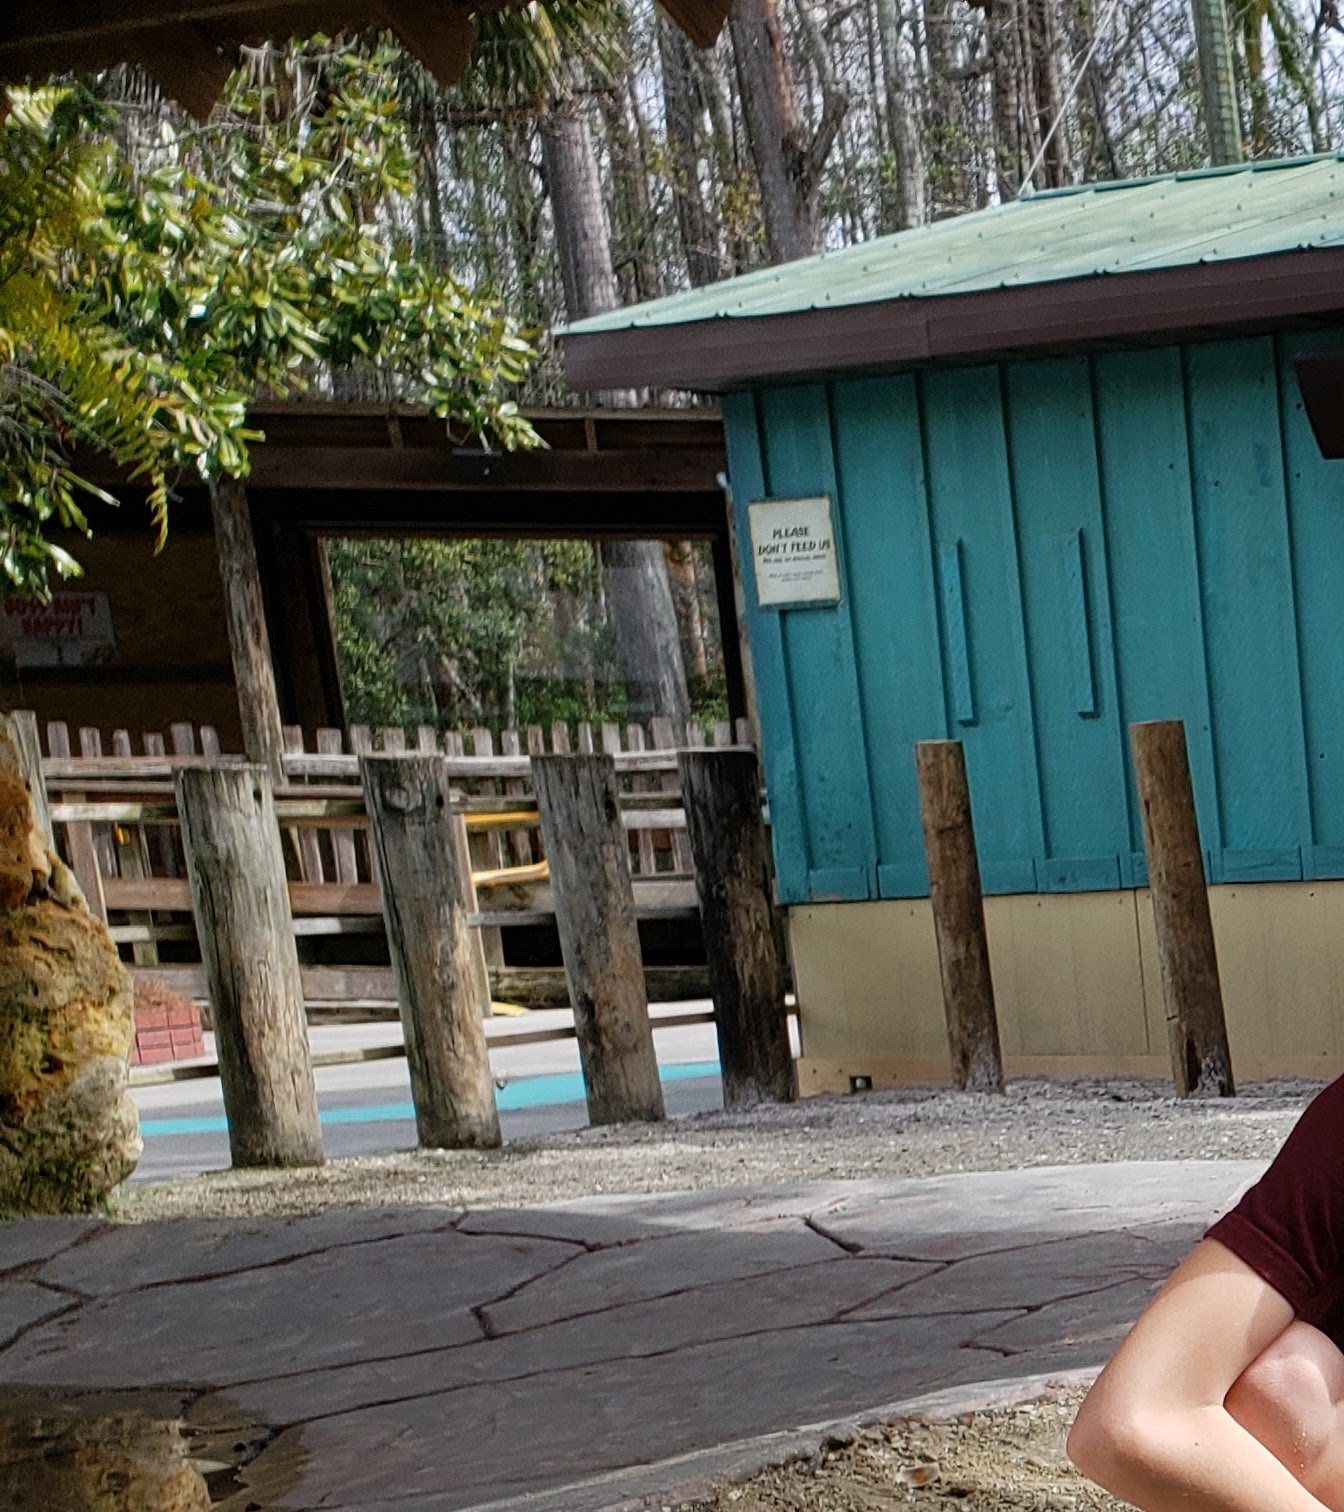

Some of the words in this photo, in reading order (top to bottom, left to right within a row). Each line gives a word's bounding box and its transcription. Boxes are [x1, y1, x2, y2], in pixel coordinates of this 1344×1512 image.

[772, 526, 809, 539] PLEASE
[758, 543, 787, 556] DON'T
[790, 541, 816, 554] FEED
[819, 539, 831, 551] US
